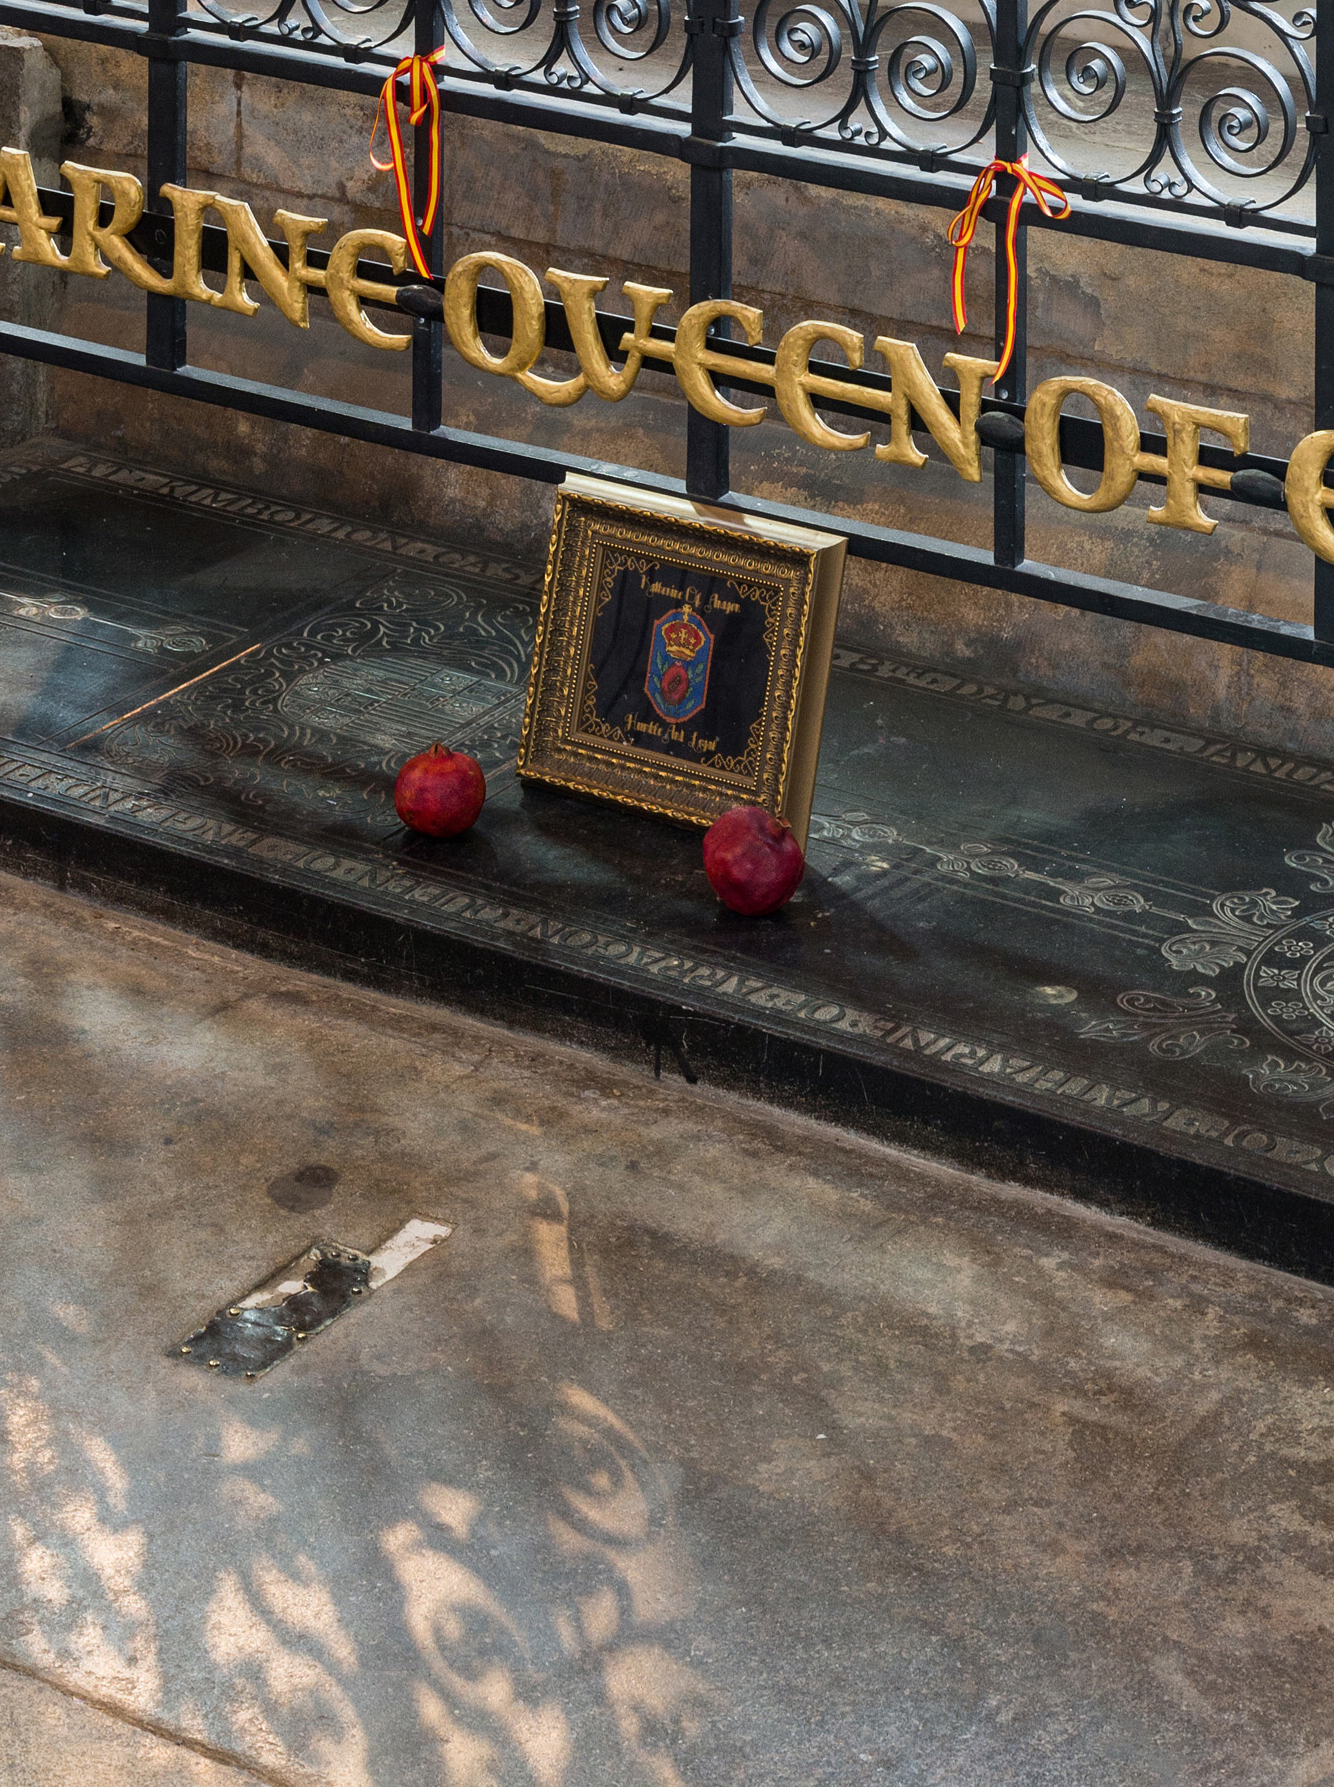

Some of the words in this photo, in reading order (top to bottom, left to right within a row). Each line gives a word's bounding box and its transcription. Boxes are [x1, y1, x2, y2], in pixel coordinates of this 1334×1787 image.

[1024, 375, 1250, 535] OF
[63, 458, 131, 480] AT
[149, 479, 417, 552] KIMBOLTON
[425, 548, 562, 589] CAST
[944, 679, 1048, 714] DAY
[1076, 713, 1155, 742] OF
[686, 586, 702, 608] Of
[45, 777, 269, 849] ENGLAND
[271, 843, 347, 873] OF
[345, 865, 518, 924] QUEEN
[519, 917, 783, 1004] ARRAGON
[764, 989, 852, 1025] OF
[854, 1016, 1180, 1124] KATHARINE
[1198, 1117, 1286, 1156] OF
